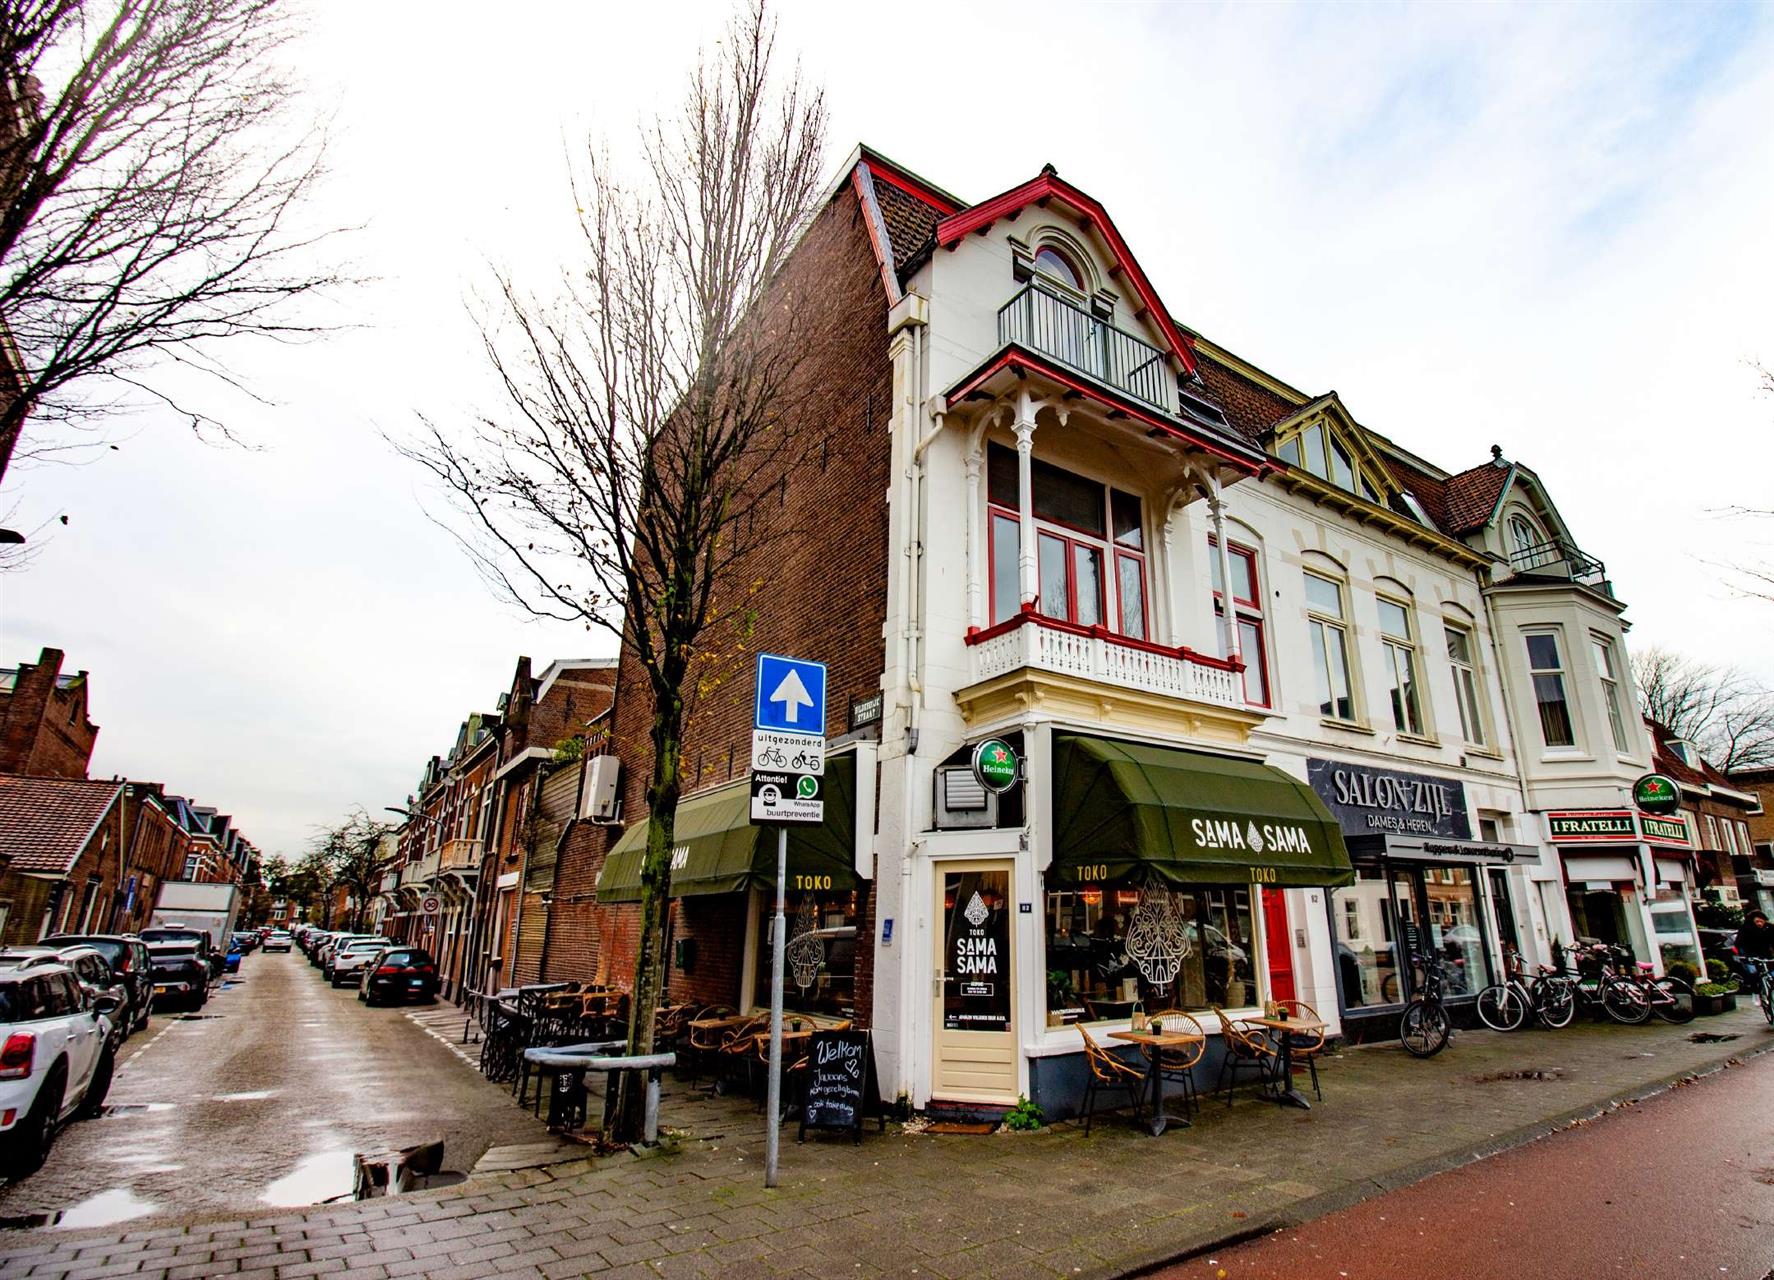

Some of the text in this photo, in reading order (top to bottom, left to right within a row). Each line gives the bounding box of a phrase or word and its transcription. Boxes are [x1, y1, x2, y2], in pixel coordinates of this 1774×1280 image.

[757, 734, 822, 748] uitgezonderd
[755, 774, 787, 784] Attentie!
[1334, 769, 1410, 811] SALON
[794, 801, 821, 809] WhatsApp
[1638, 794, 1674, 803] Heineken
[767, 809, 820, 819] buurtpreventie
[1367, 814, 1432, 832] DAMES & HEREN
[1552, 820, 1632, 832] I FRATELLI
[1648, 820, 1684, 839] FRATELLI
[1191, 818, 1312, 854] SAMA SAMA
[1077, 865, 1108, 881] TOKO
[1250, 867, 1277, 883] TOKO
[796, 875, 831, 890] TOKO
[957, 938, 997, 955] SAMA
[957, 956, 997, 974] SAMA
